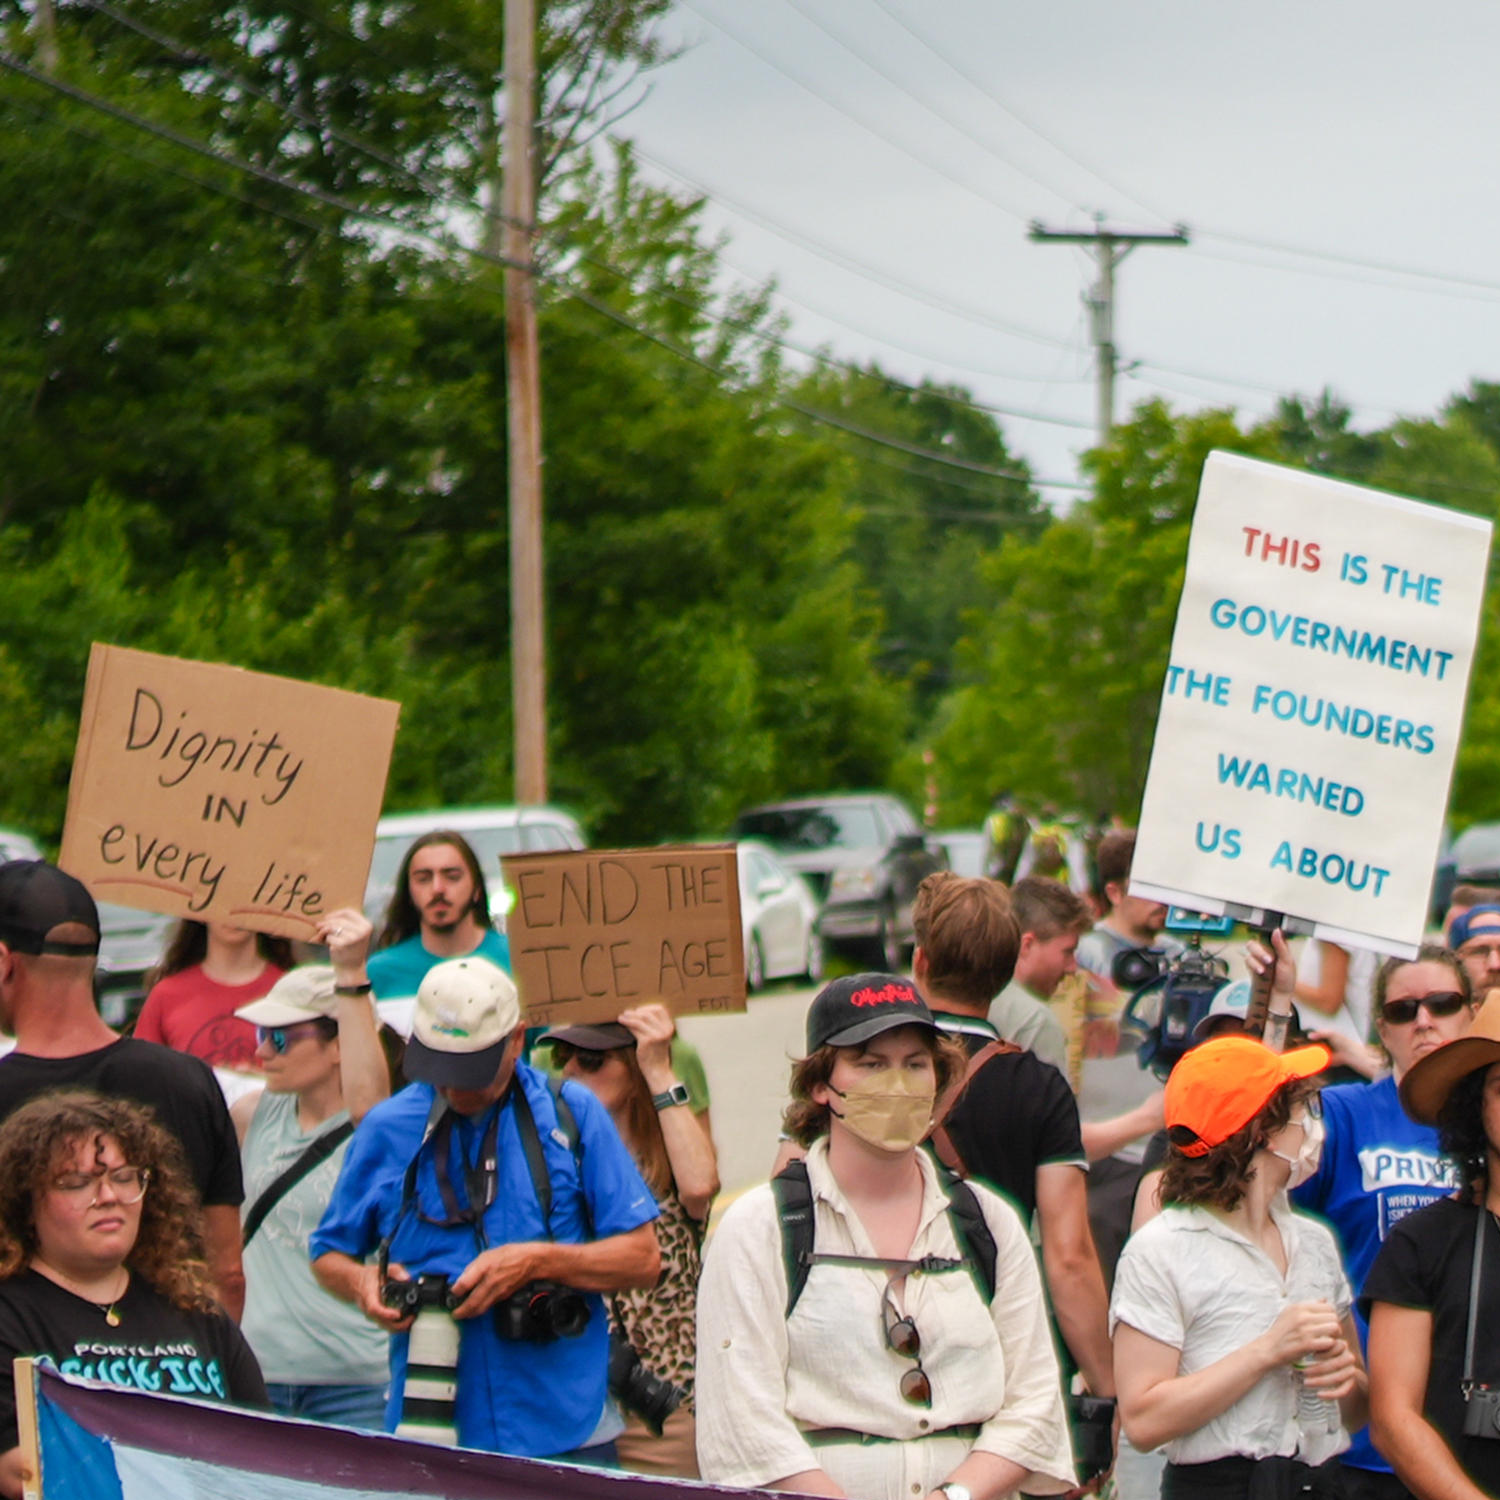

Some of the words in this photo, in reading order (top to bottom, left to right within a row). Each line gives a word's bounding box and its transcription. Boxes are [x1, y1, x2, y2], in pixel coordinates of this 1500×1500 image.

[1242, 526, 1322, 573] THIS
[1340, 552, 1370, 586] IS
[1382, 564, 1443, 606] THE
[1210, 598, 1454, 681] GOVERNMENT
[1166, 664, 1232, 707] THE
[1251, 684, 1436, 755] FOUNDERS
[126, 688, 304, 806] Dignity
[201, 794, 248, 828] IN
[1217, 753, 1366, 817] WARNED
[100, 824, 227, 912] every
[252, 861, 324, 916] life
[518, 860, 639, 929] END
[651, 863, 723, 912] THE
[1196, 822, 1243, 860] US
[1269, 840, 1392, 898] ABOUT
[521, 940, 640, 1008] ICE
[658, 938, 731, 995] AGE
[1386, 1194, 1416, 1208] WHEN
[74, 1343, 197, 1357] PORTLAND
[159, 1358, 225, 1399] ICE
